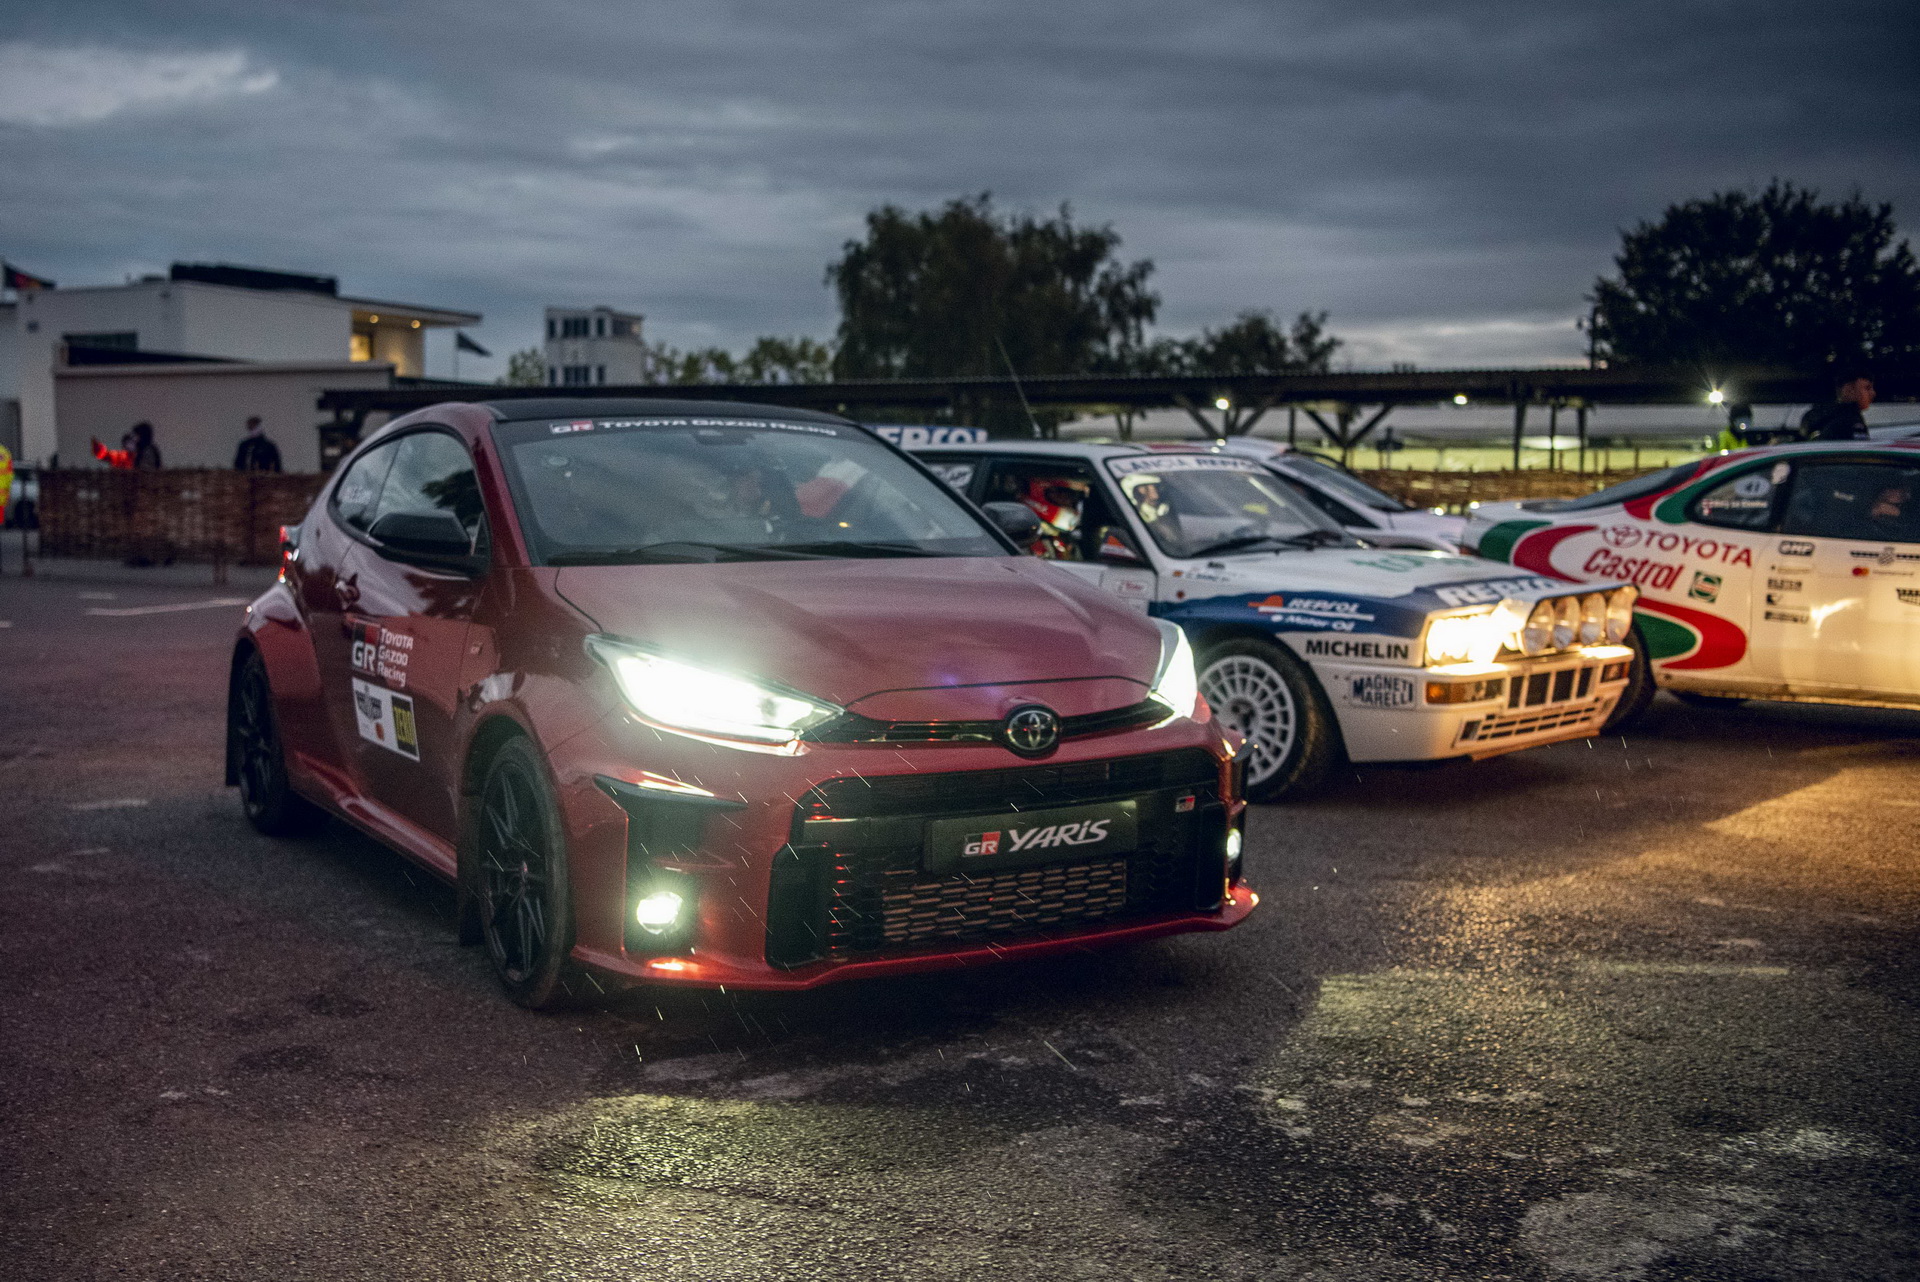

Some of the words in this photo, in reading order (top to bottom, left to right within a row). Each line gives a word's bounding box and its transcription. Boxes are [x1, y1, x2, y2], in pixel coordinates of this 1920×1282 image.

[598, 420, 687, 428] TOYOTA
[770, 422, 837, 436] Racing
[1645, 530, 1753, 568] TOYOTA
[1583, 548, 1684, 590] Castrol
[1288, 598, 1360, 613] REPSOL
[381, 627, 414, 651] TOYOTA
[1305, 640, 1409, 659] MICHELIN
[352, 640, 376, 672] GR
[377, 661, 406, 688] Racing
[962, 840, 997, 855] GR
